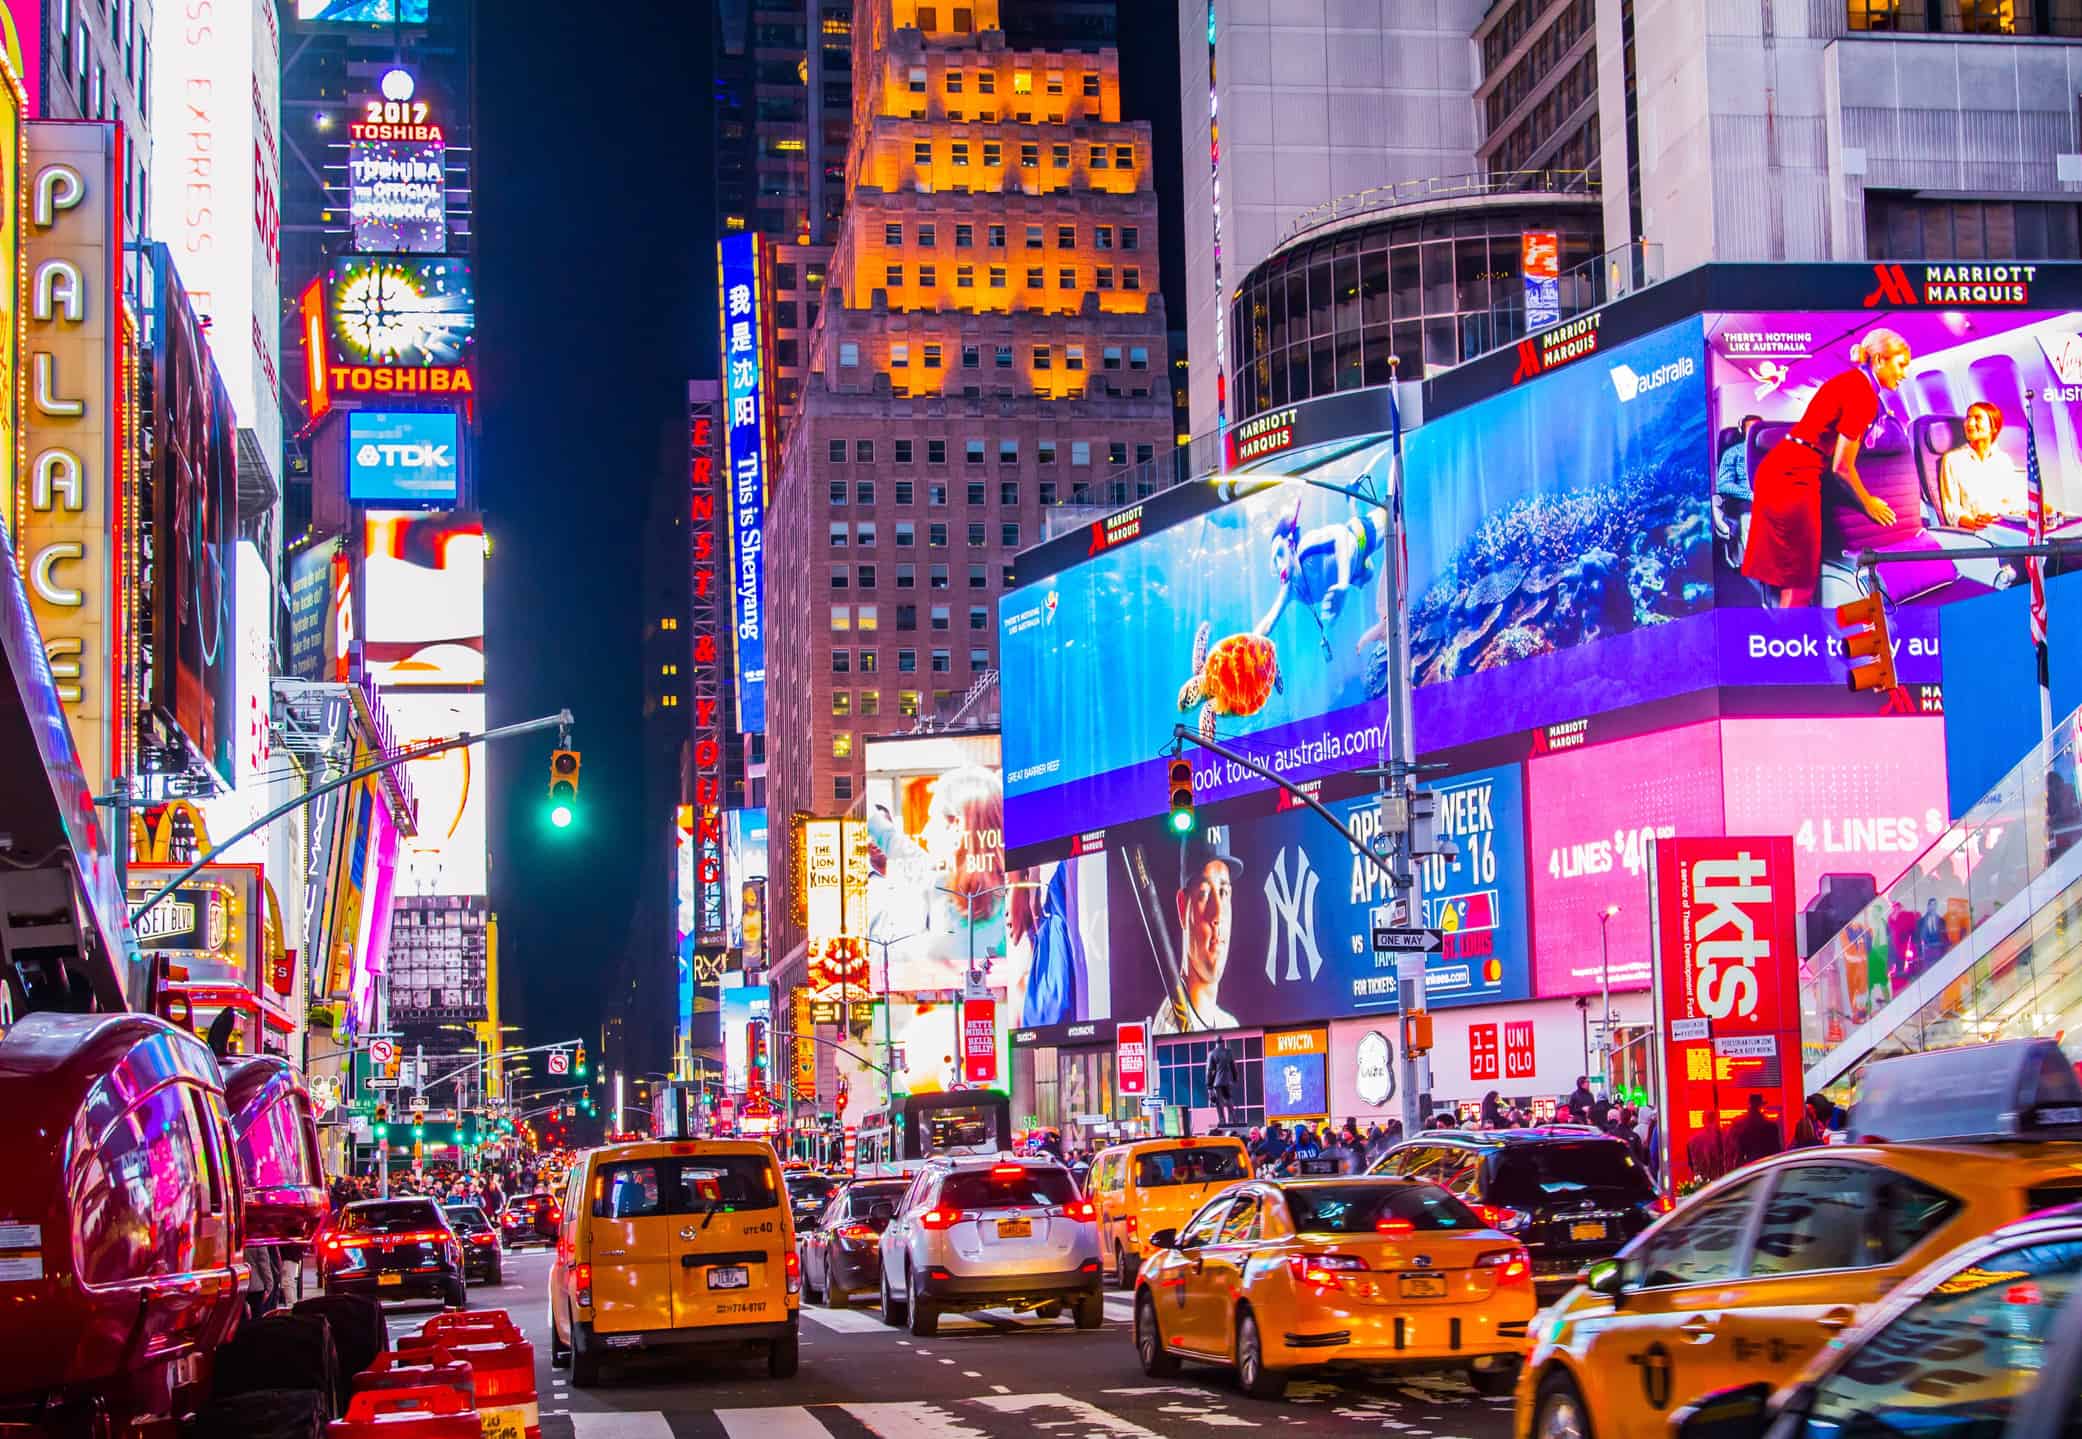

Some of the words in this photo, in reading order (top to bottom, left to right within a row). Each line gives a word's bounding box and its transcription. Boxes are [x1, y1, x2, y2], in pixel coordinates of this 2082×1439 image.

[367, 102, 428, 124] 2017
[351, 125, 444, 140] TOSHIBA
[1926, 266, 2036, 283] MARRIOTT
[1927, 285, 2025, 302] MARQUIS
[1543, 314, 1601, 349] MARRIOTT
[1724, 333, 1763, 342] THERE'S
[1766, 333, 1812, 342] NOTHING
[729, 284, 755, 428] 我是沈阳
[1544, 333, 1596, 367] MARQUIS
[1730, 343, 1750, 352] LIKE
[1753, 343, 1807, 352] AUSTRALIA
[331, 368, 473, 391] TOSHIBA
[1638, 358, 1694, 394] australia
[30, 164, 85, 703] PALACE
[1239, 408, 1298, 440] MARRIOTT
[379, 444, 450, 468] TDK
[1240, 429, 1292, 460] MARQUIS
[738, 451, 759, 505] This
[740, 506, 760, 533] is
[1106, 505, 1144, 532] MARRIOTT
[1107, 521, 1141, 545] MARQUIS
[738, 529, 762, 641] Shenyang
[1748, 635, 1818, 658] Book
[1549, 720, 1588, 738] MARRIOTT
[1550, 734, 1585, 750] MARQUIS
[1191, 760, 1222, 792] ook
[1226, 751, 1270, 782] today
[1797, 820, 1817, 853] 4
[1823, 816, 1919, 852] LINES
[814, 846, 831, 856] THE
[1468, 831, 1497, 886] 16
[1549, 848, 1560, 879] 4
[1562, 840, 1613, 878] LINES
[966, 854, 995, 873] BUT
[810, 871, 839, 889] KING
[1352, 934, 1363, 954] VS
[1380, 935, 1400, 946] ONE
[1402, 934, 1424, 946] WAY
[1460, 929, 1493, 957] LOUIS
[1354, 978, 1368, 996] FOR
[1368, 975, 1397, 995] TICKETS:
[1277, 1033, 1315, 1052] INVICTA
[1507, 1027, 1530, 1048] UNI
[1508, 1052, 1533, 1075] QLO
